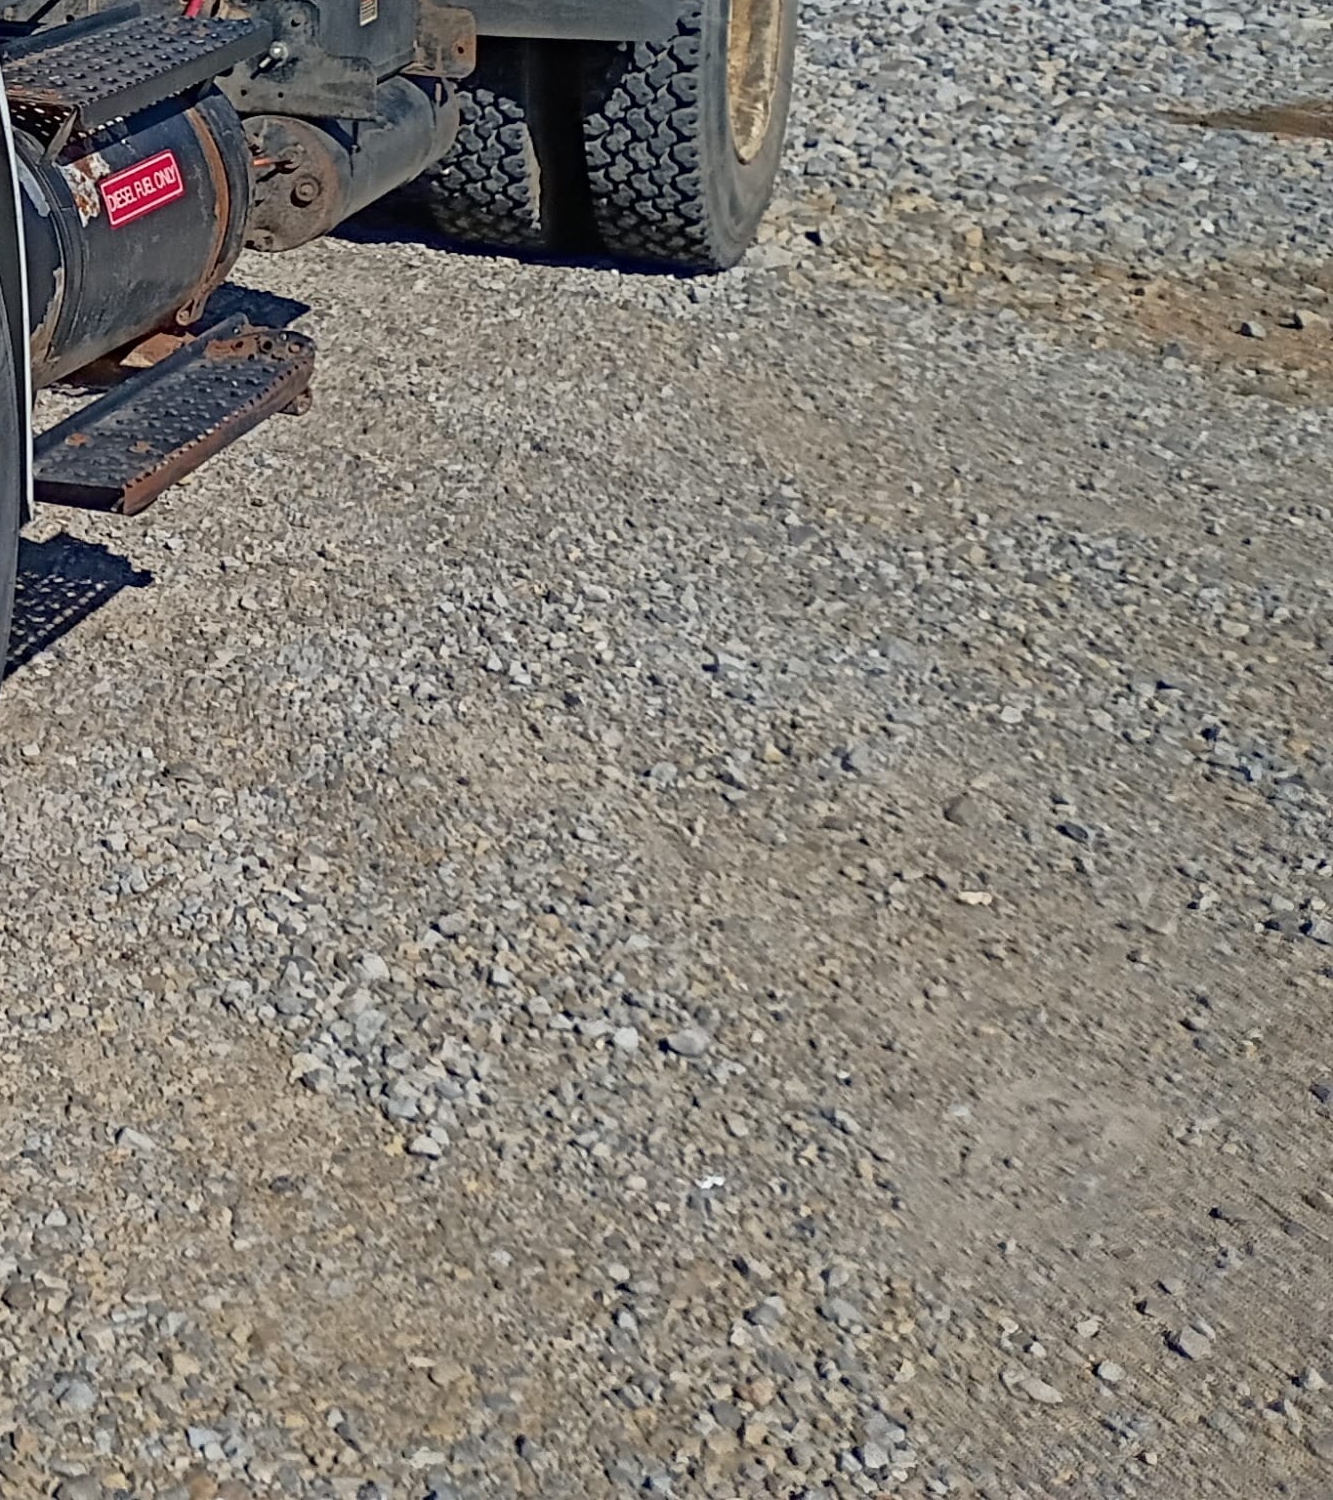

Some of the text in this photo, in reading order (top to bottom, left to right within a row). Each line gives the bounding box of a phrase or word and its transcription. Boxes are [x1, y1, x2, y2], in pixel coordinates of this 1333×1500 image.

[106, 165, 176, 212] DIESEL FUEL ONLY
